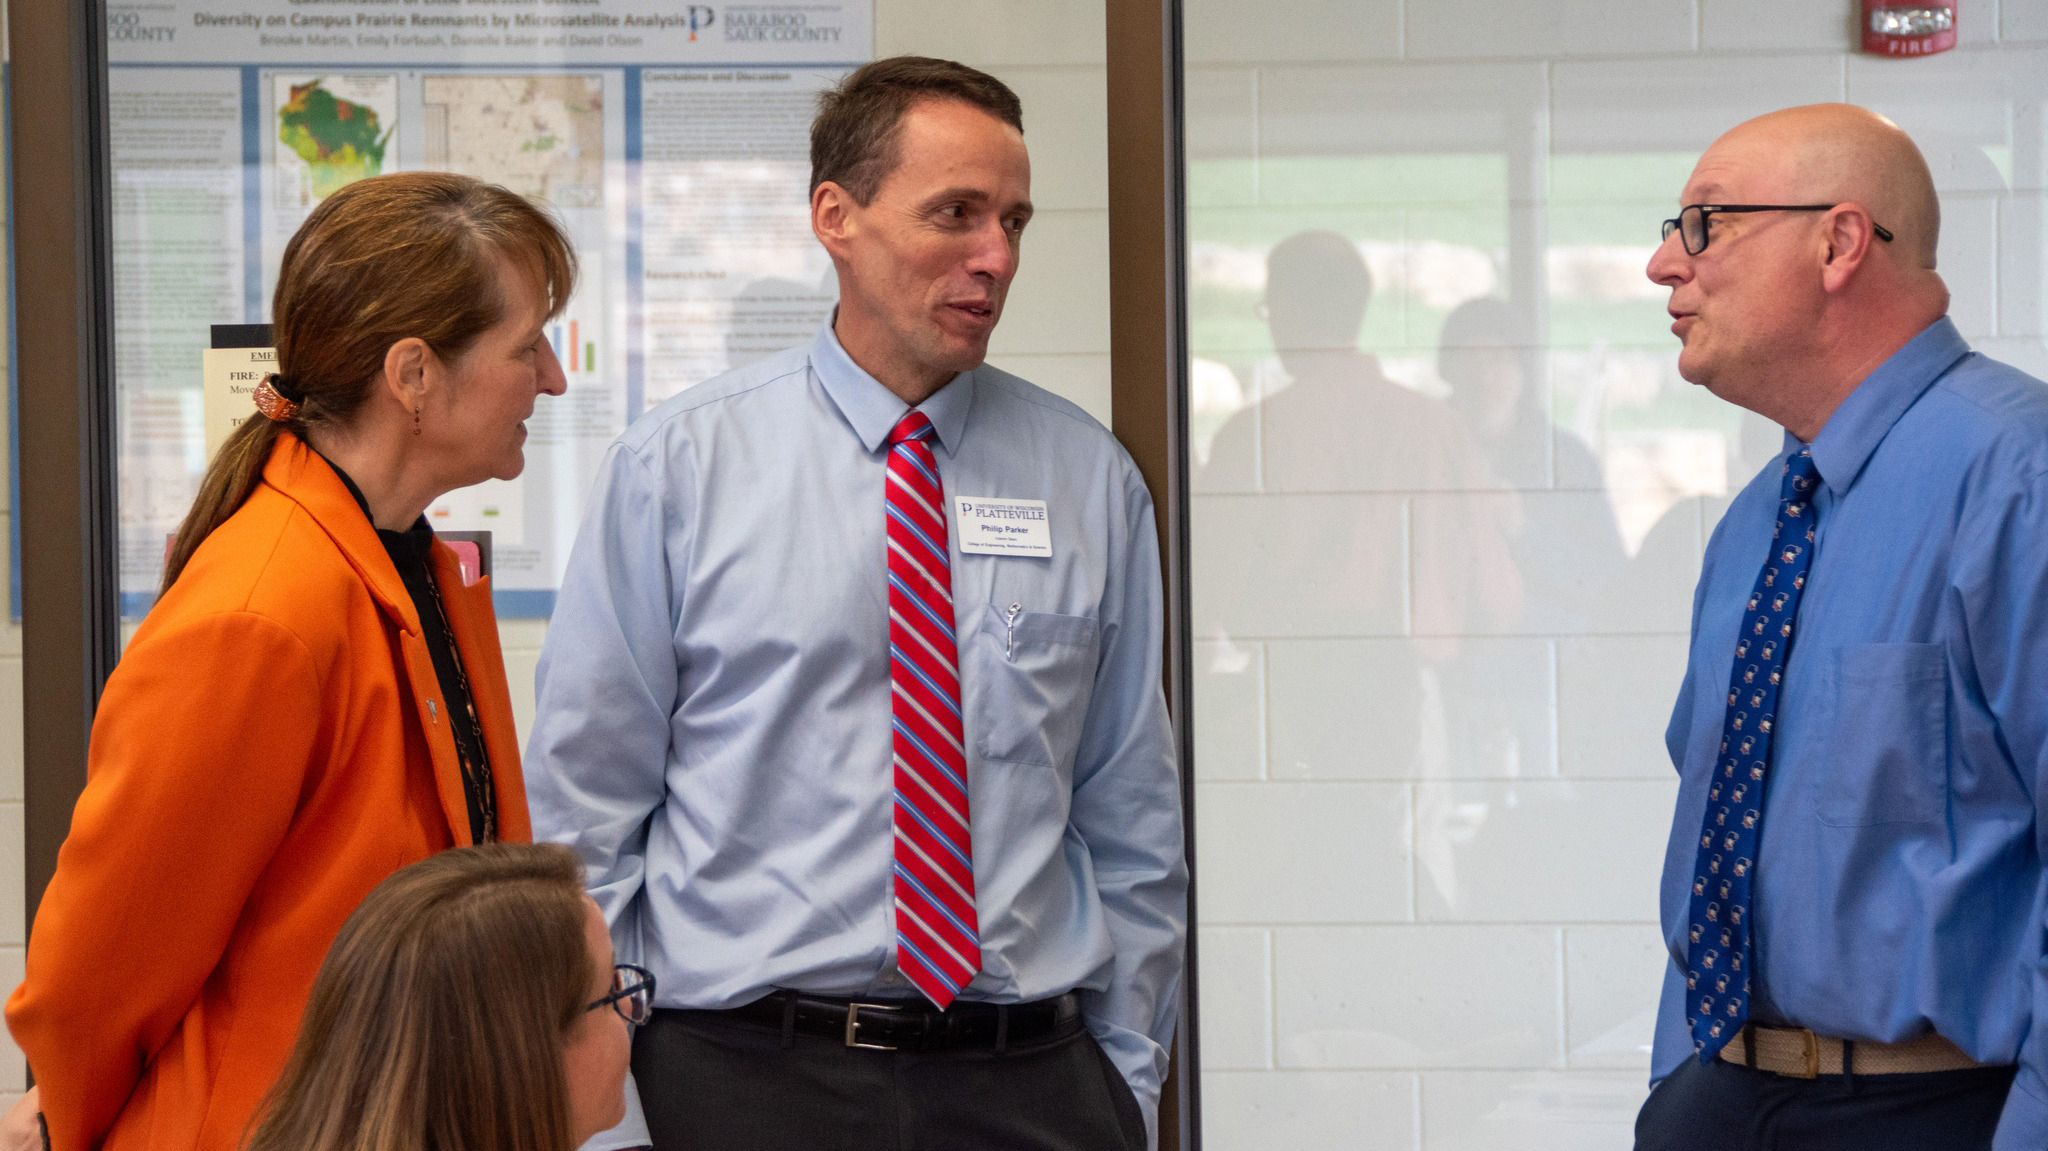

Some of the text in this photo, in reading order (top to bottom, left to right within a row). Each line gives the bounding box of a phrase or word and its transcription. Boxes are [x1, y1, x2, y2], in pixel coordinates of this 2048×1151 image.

[193, 12, 686, 30] Diversity on Campus Prairie Remnants by Microsatellite Analysis
[724, 13, 806, 26] BARABOO
[724, 26, 842, 41] SAUK COUNTY
[260, 33, 303, 46] Brooke
[356, 33, 389, 48] Emily
[451, 34, 499, 46] Danielle
[504, 34, 538, 46] Baker
[543, 34, 566, 46] and
[569, 34, 603, 46] David
[607, 34, 643, 46] Olson
[1889, 40, 1932, 54] FIRE
[644, 71, 792, 82] Conclusions and Discussion
[230, 371, 259, 380] FIRE:
[976, 508, 1045, 520] PLATTEVILLE
[981, 525, 1029, 534] Philip Parker
